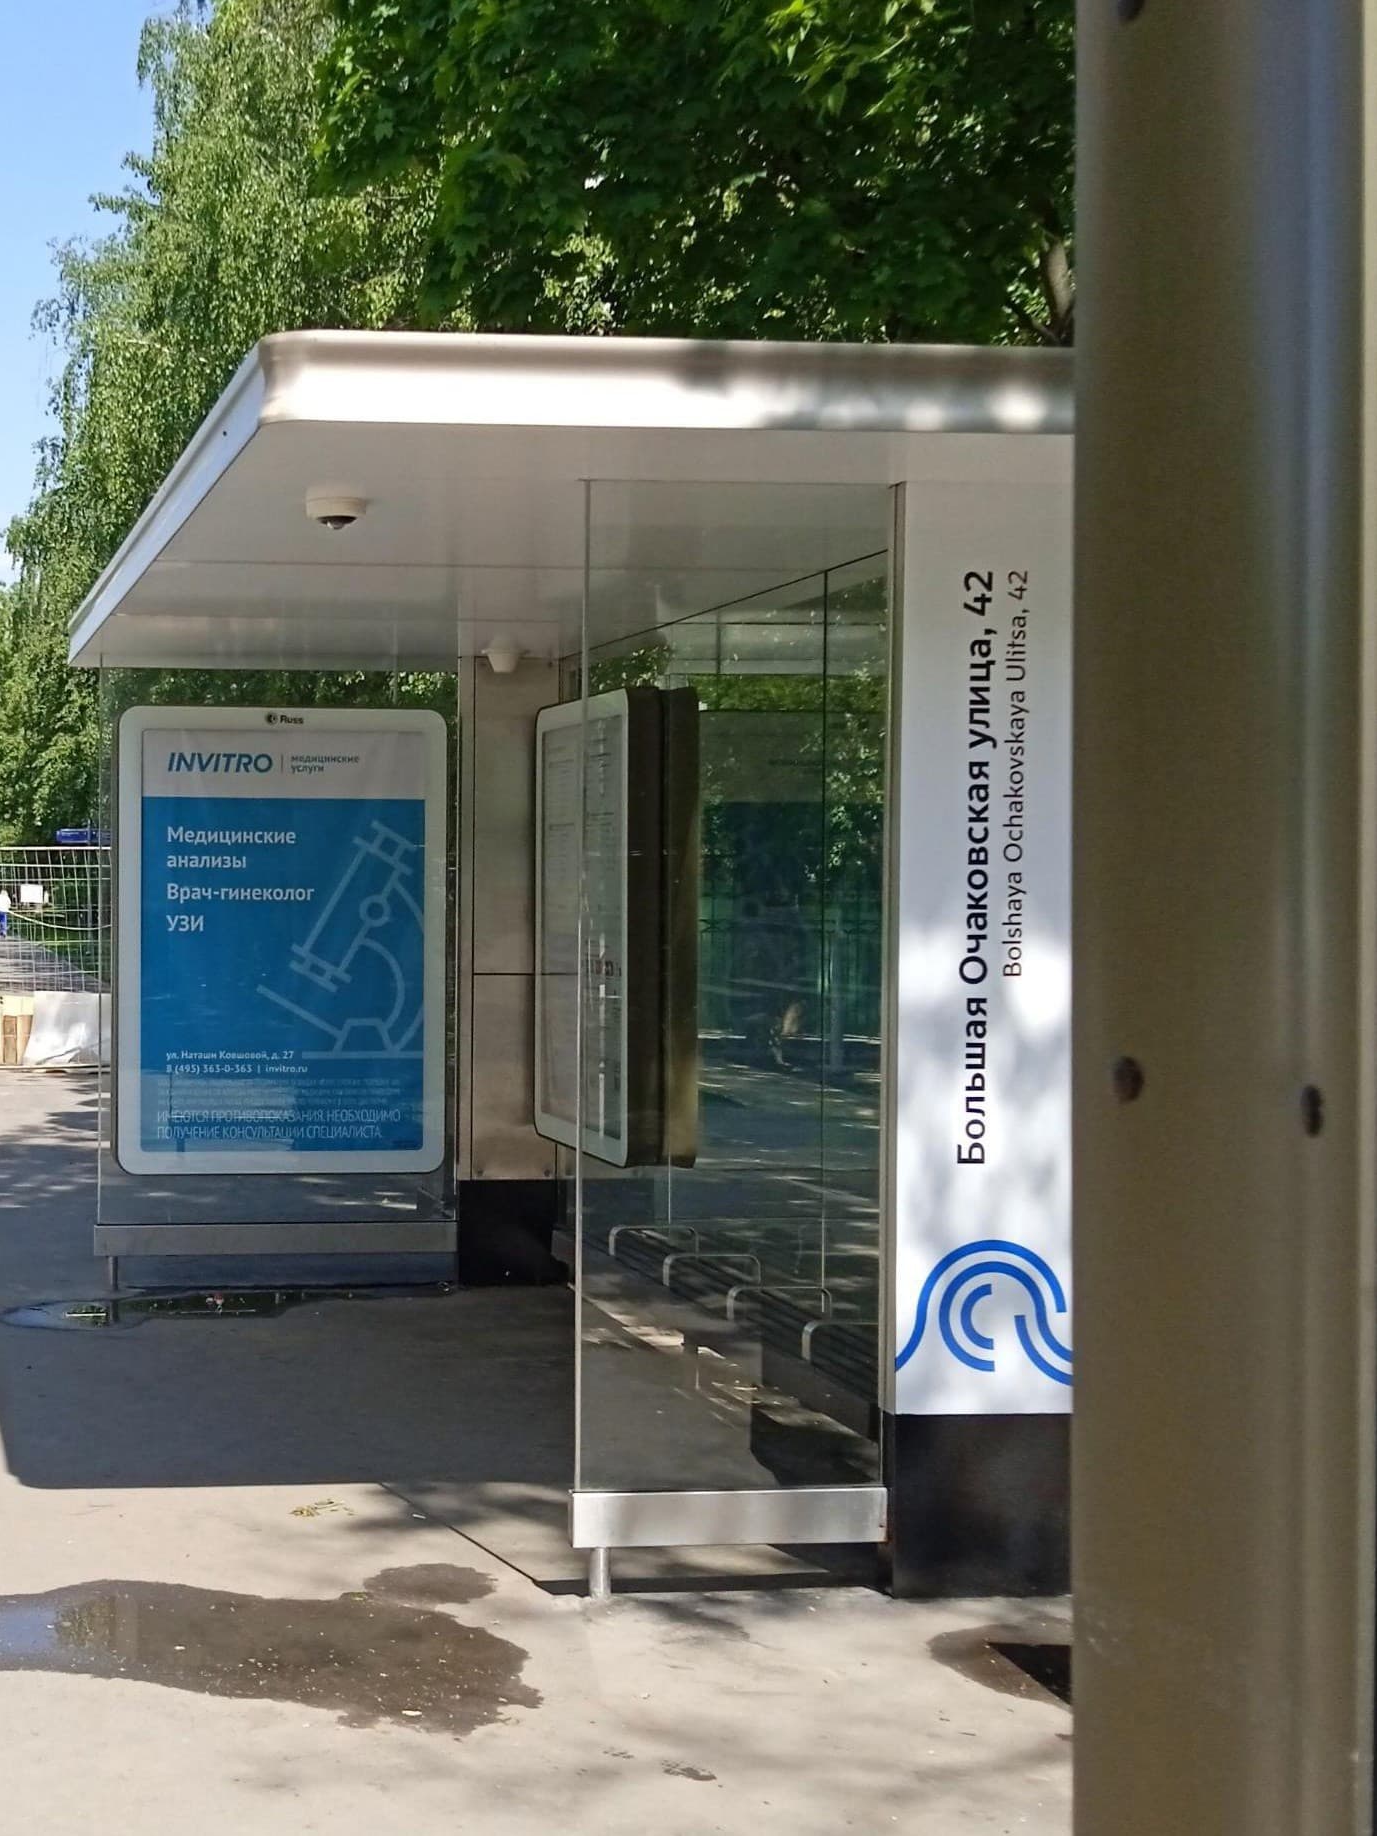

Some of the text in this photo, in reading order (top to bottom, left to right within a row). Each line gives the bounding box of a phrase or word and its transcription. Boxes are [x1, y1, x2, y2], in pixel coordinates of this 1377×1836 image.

[280, 714, 304, 725] Russ
[167, 752, 273, 774] INVITRO
[290, 755, 360, 764] медицинские
[290, 764, 324, 775] услуги
[1001, 570, 1031, 978] Bolshaya Ochakovskaya Ulitsa, 42
[167, 826, 296, 846] Медицинские
[167, 854, 246, 869] анализы
[957, 571, 997, 1164] Большая Очаковская улица, 42
[167, 883, 315, 904] Врач-гинеколог
[166, 915, 204, 932] УЗИ
[166, 1050, 295, 1061] ул. Наташи Ковшовой, д. 27
[175, 1064, 200, 1075] (495)
[265, 1063, 308, 1073] invitro.ru
[327, 1109, 401, 1123] НЕОБХОДИМО
[157, 1126, 220, 1140] ПОЛУЧЕНИЕ
[222, 1126, 304, 1139] КОНСУЛЬТАЦИИ
